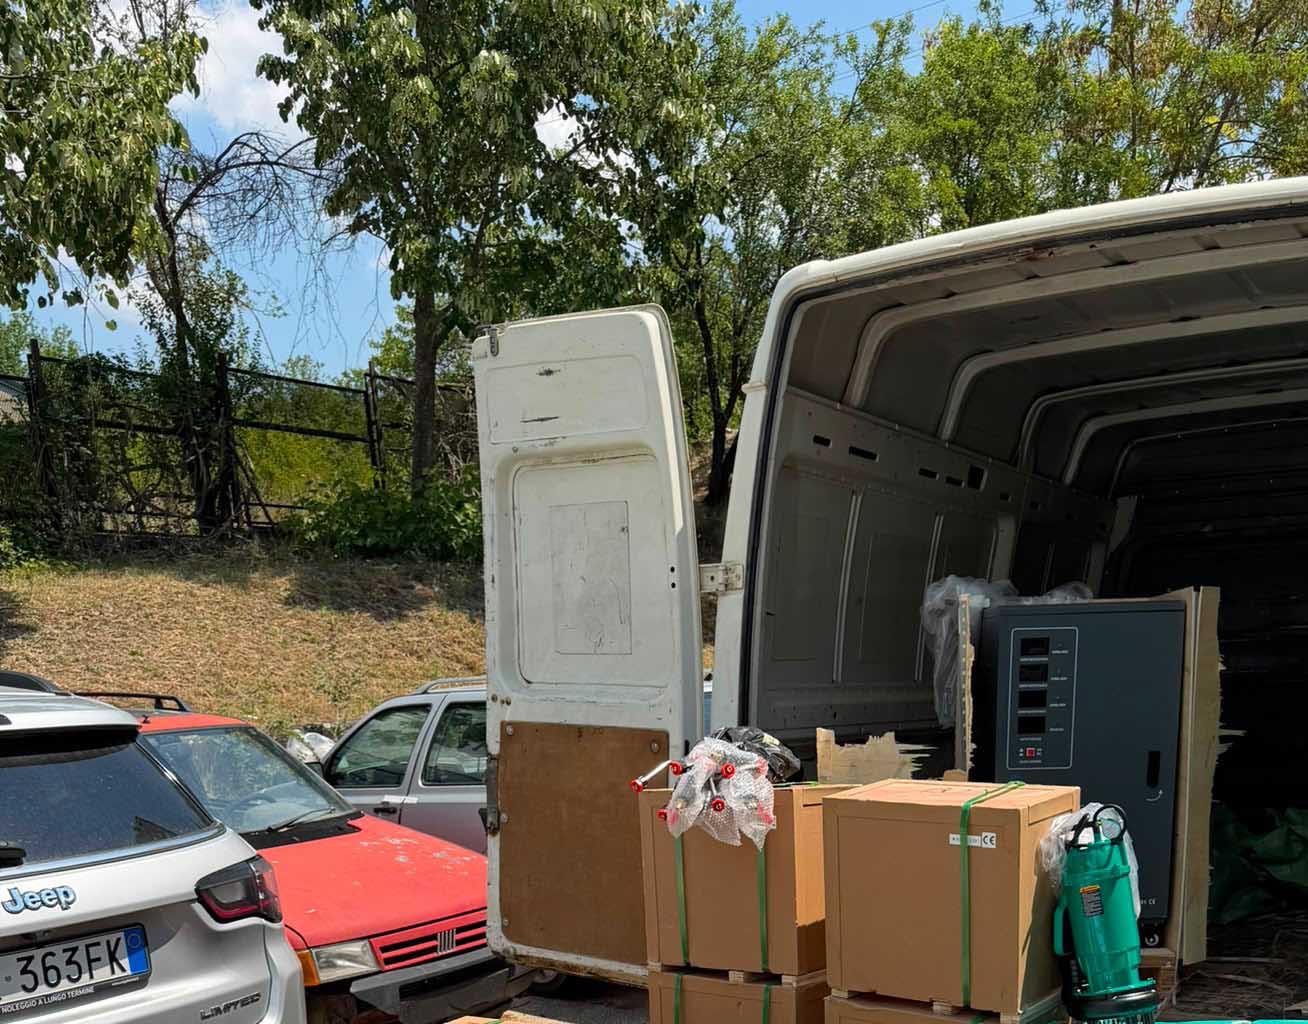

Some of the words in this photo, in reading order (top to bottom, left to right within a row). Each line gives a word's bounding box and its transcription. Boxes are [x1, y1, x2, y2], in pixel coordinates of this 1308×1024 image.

[2, 885, 77, 915] Jeep
[16, 935, 128, 993] 363FK
[44, 993, 67, 1005] LUNGO
[66, 986, 95, 1000] TERMINE
